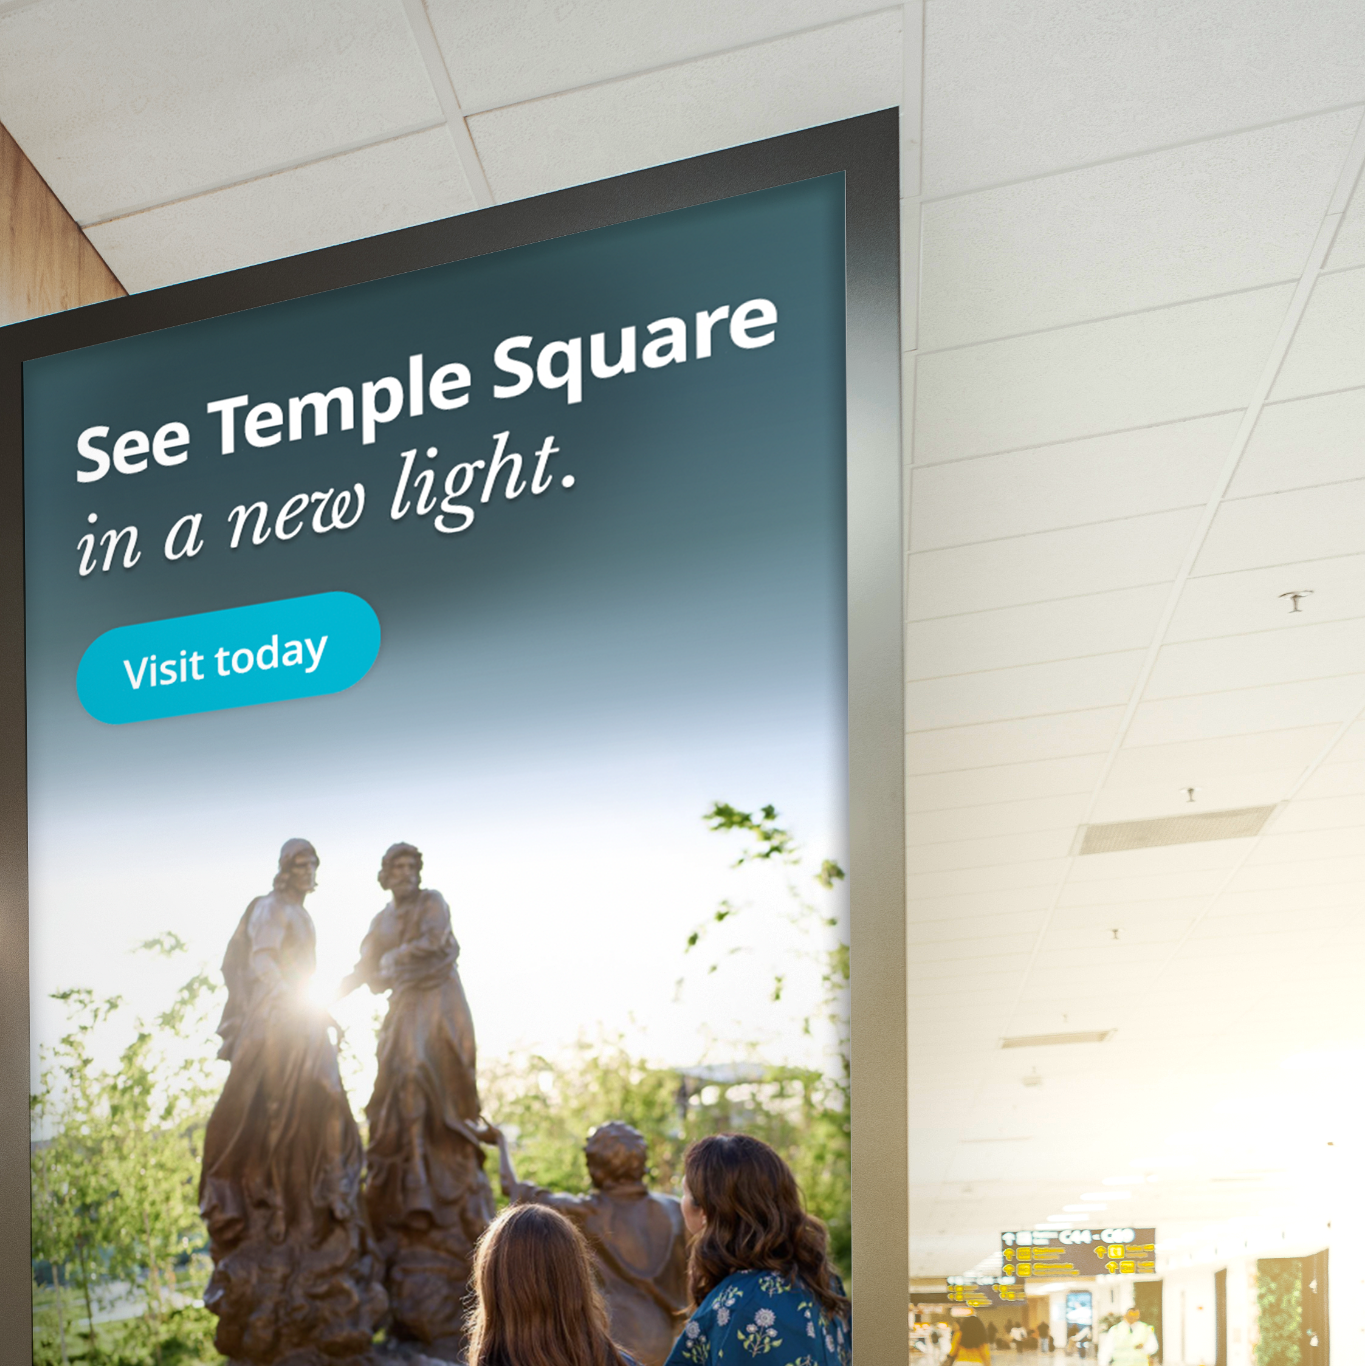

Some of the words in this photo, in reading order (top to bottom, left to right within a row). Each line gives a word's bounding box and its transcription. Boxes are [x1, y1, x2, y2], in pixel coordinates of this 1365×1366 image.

[76, 421, 190, 483] See
[207, 353, 471, 456] Temple
[493, 298, 778, 405] Square
[77, 512, 142, 576] in
[164, 513, 204, 560] a
[227, 482, 365, 548] new
[390, 430, 575, 534] light.
[123, 648, 206, 690] Visit
[214, 633, 329, 677] today
